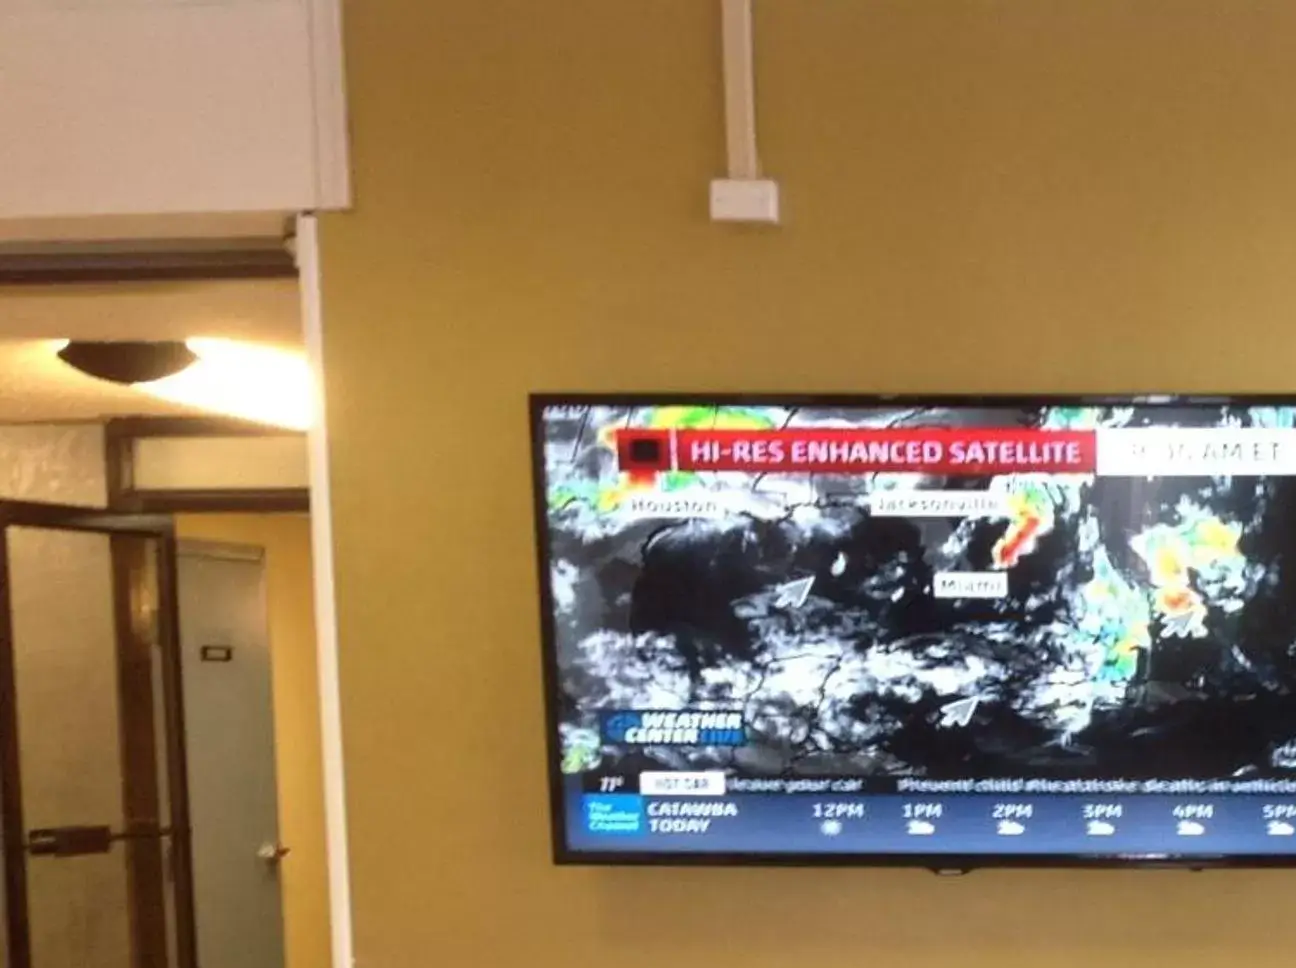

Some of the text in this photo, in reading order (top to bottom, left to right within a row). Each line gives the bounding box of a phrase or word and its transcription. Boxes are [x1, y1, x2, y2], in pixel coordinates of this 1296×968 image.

[691, 440, 1081, 464] HI-RES ENHANCED SATELLITE
[649, 819, 711, 832] TODAY
